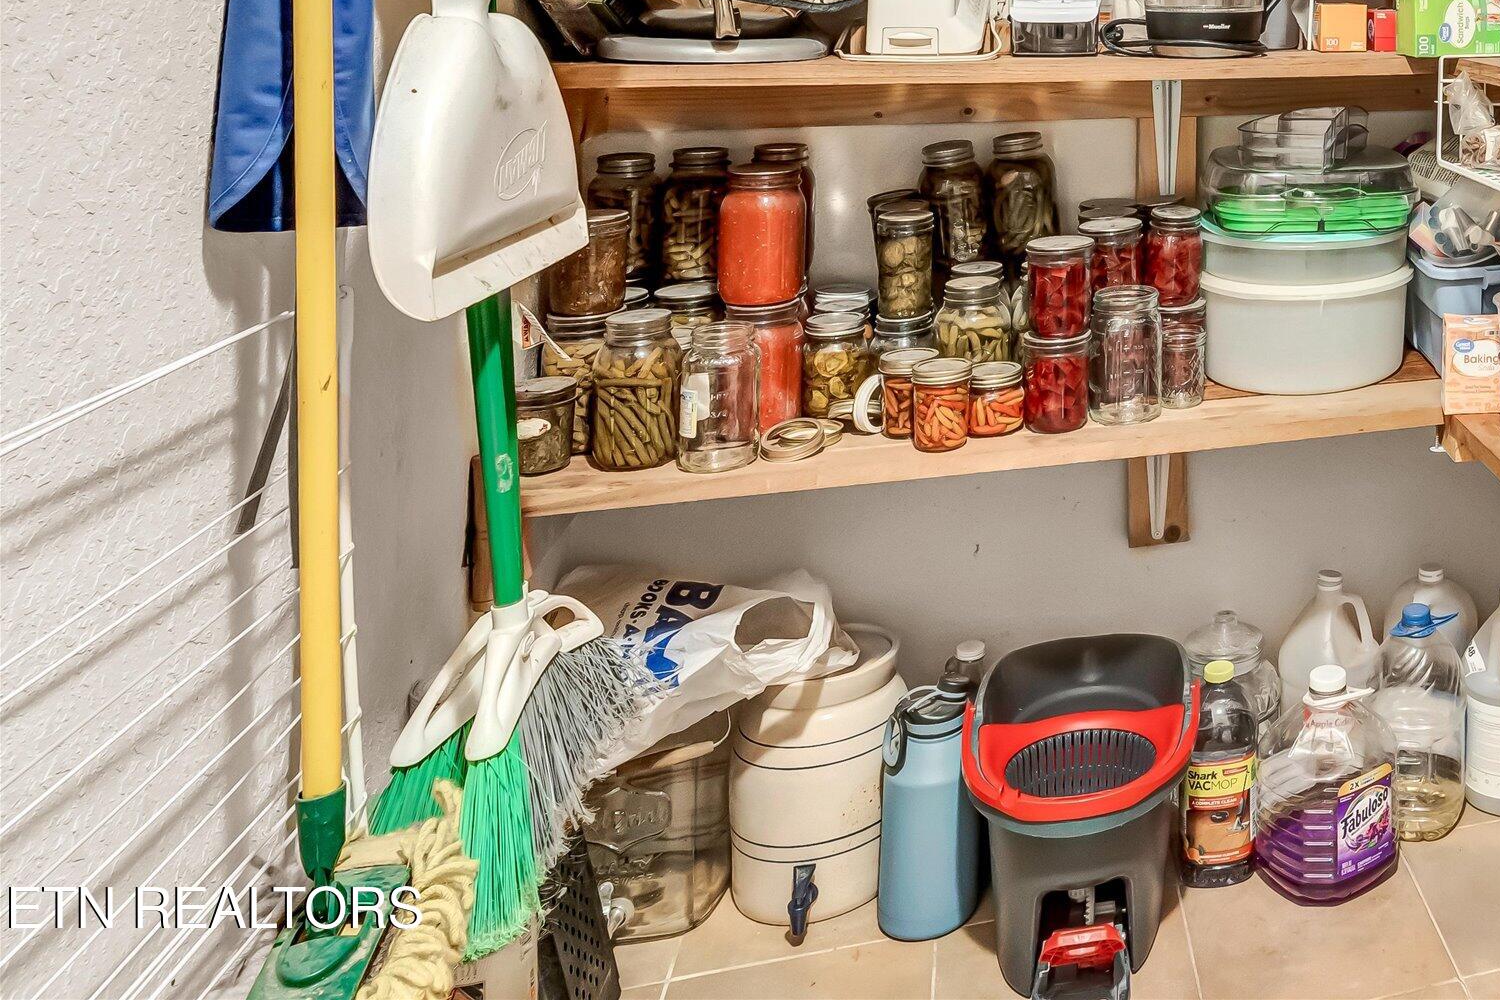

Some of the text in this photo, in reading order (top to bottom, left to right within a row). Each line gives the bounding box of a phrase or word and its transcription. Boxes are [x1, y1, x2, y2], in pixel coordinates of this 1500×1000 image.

[1325, 38, 1339, 46] 100
[1418, 35, 1430, 55] 100
[1463, 354, 1499, 366] Baking
[1187, 770, 1217, 780] Shark
[1349, 782, 1360, 791] 2X
[1340, 787, 1389, 839] Fabuloso
